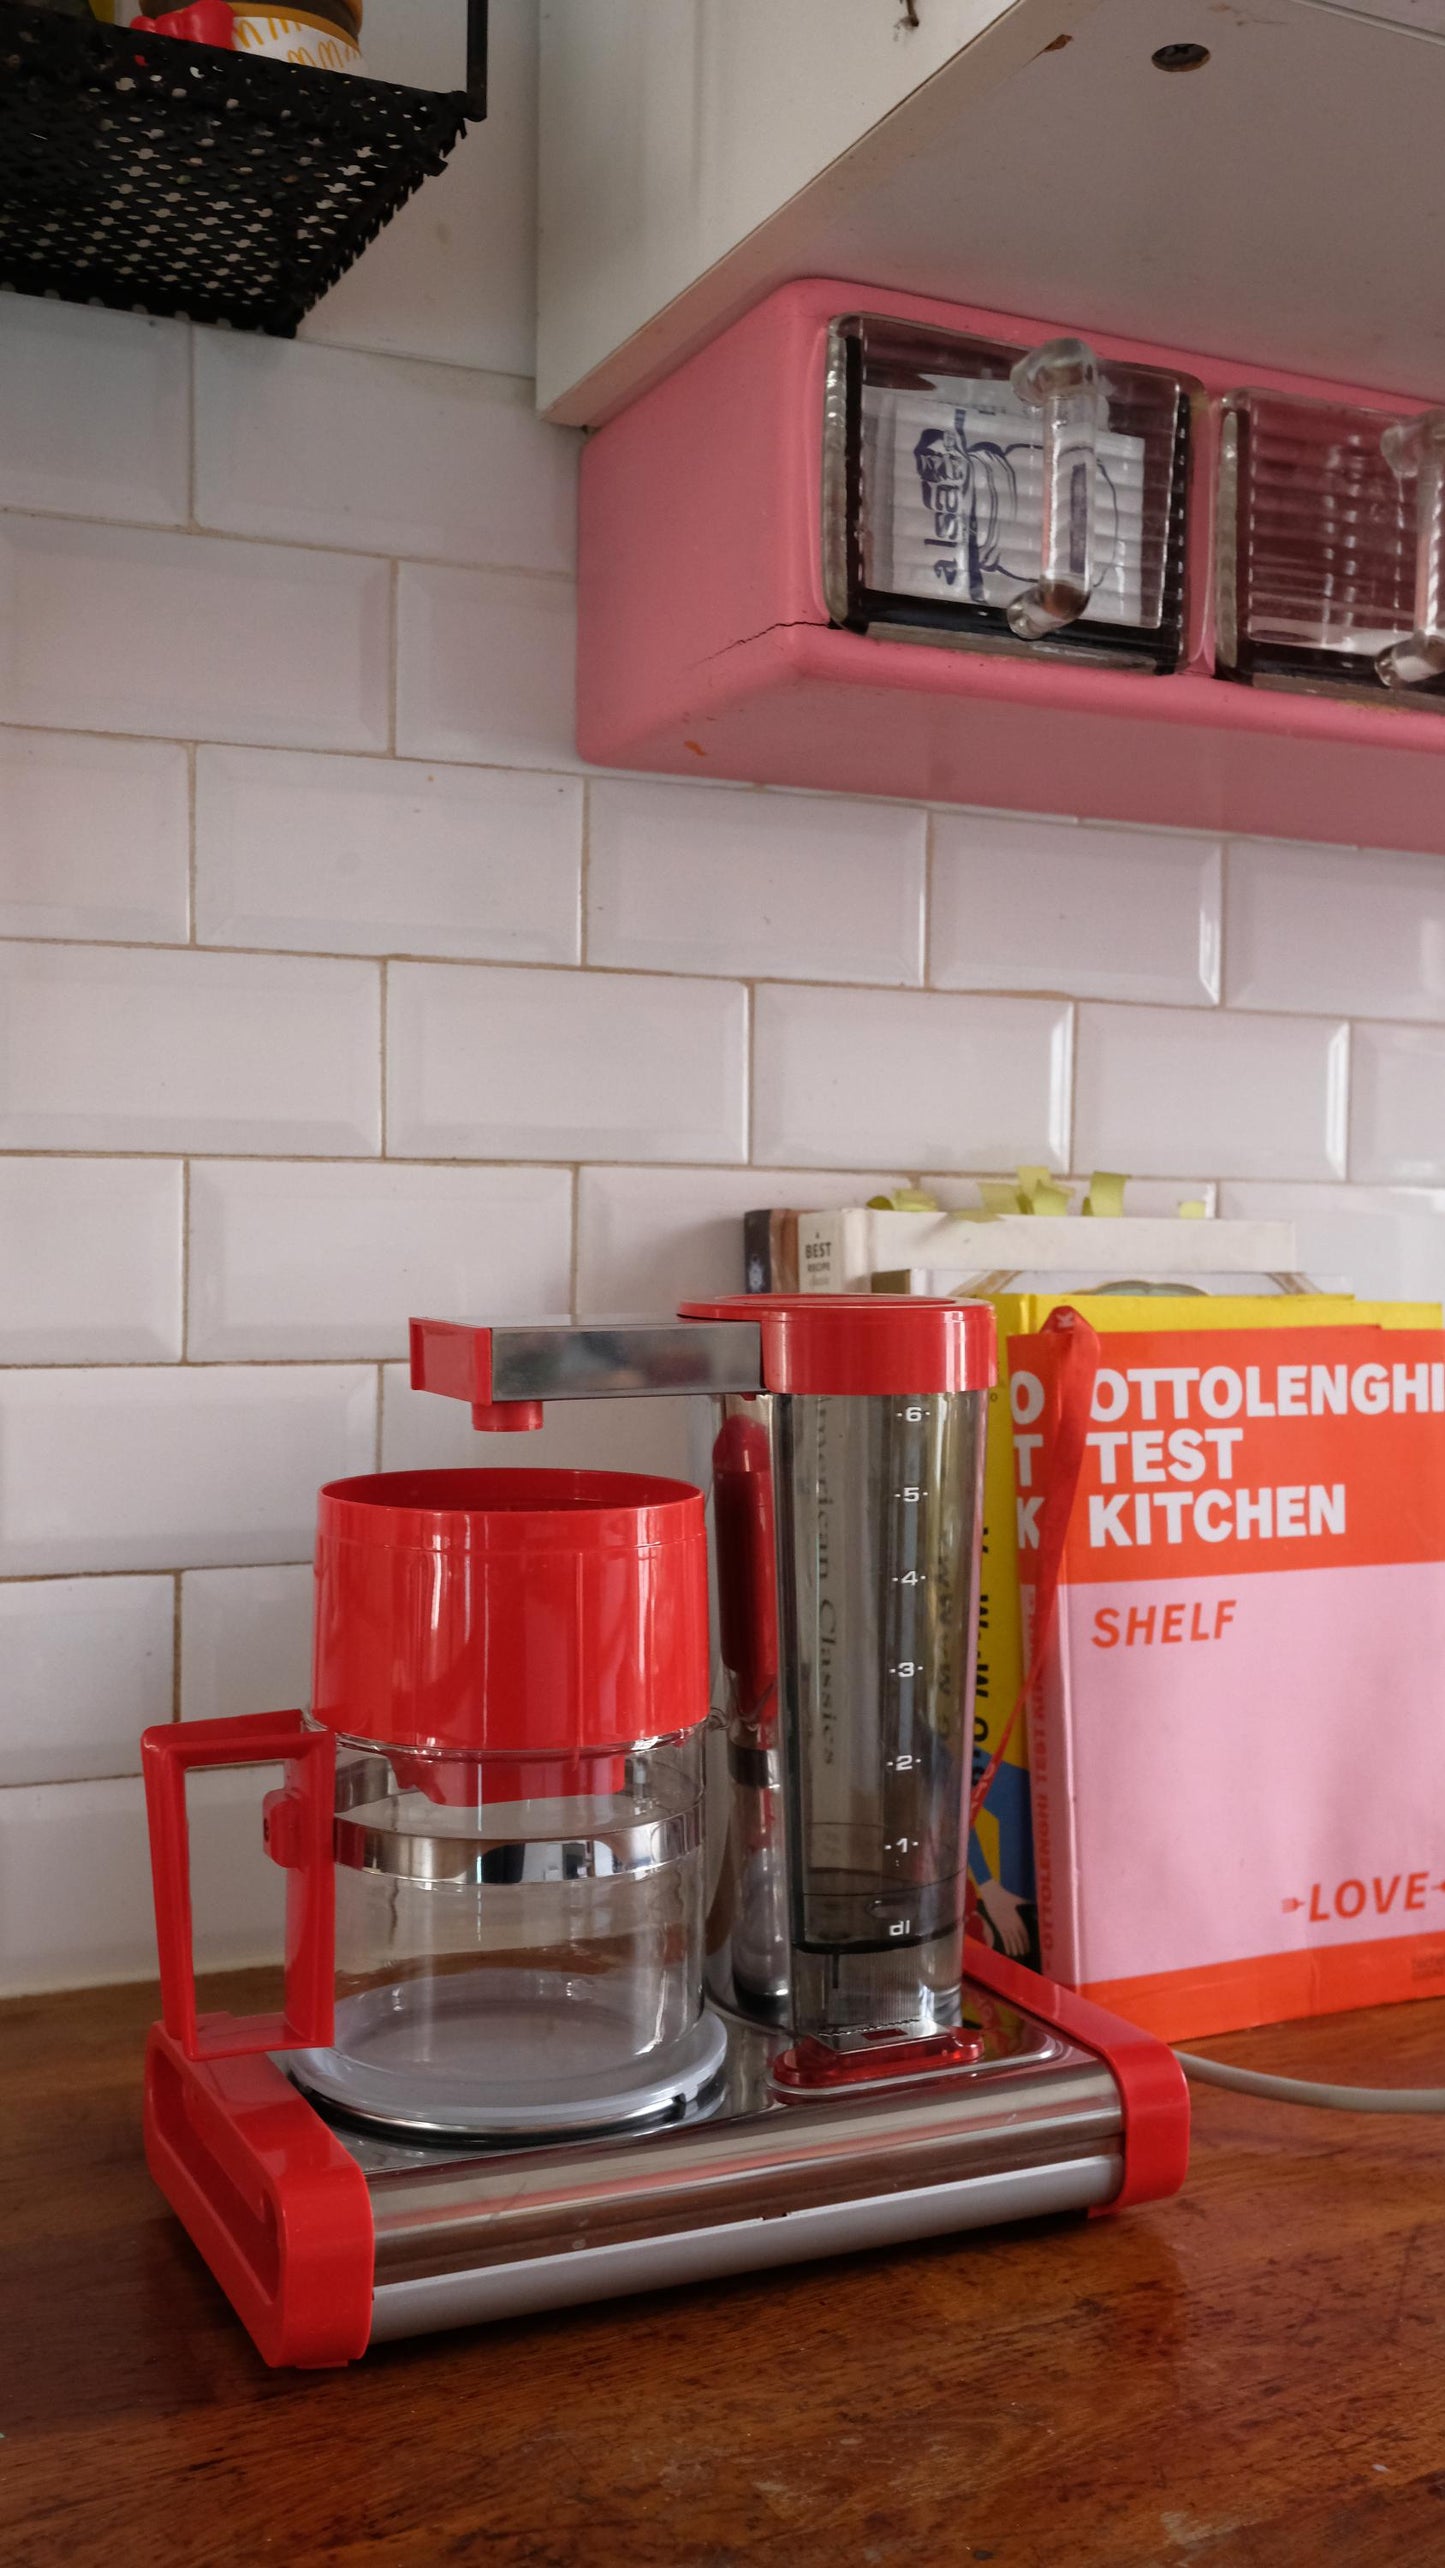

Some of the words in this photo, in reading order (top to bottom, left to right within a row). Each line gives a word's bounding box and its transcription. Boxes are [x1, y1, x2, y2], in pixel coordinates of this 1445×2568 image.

[804, 1241, 832, 1259] BEST
[807, 1262, 831, 1273] RECIPE
[1010, 1370, 1046, 1425] O
[1089, 1363, 1445, 1423] OTTOLENGHI
[1013, 1434, 1044, 1487] T
[1085, 1427, 1243, 1484] TEST
[1088, 1484, 1346, 1548] KITCHEN
[1091, 1599, 1237, 1649] SHELF
[820, 1599, 838, 1765] Classics
[1033, 1728, 1048, 1784] TEST
[1035, 1794, 1054, 1951] OTTOLENGHI
[1308, 1870, 1430, 1923] LOVE
[888, 1920, 911, 1937] dl
